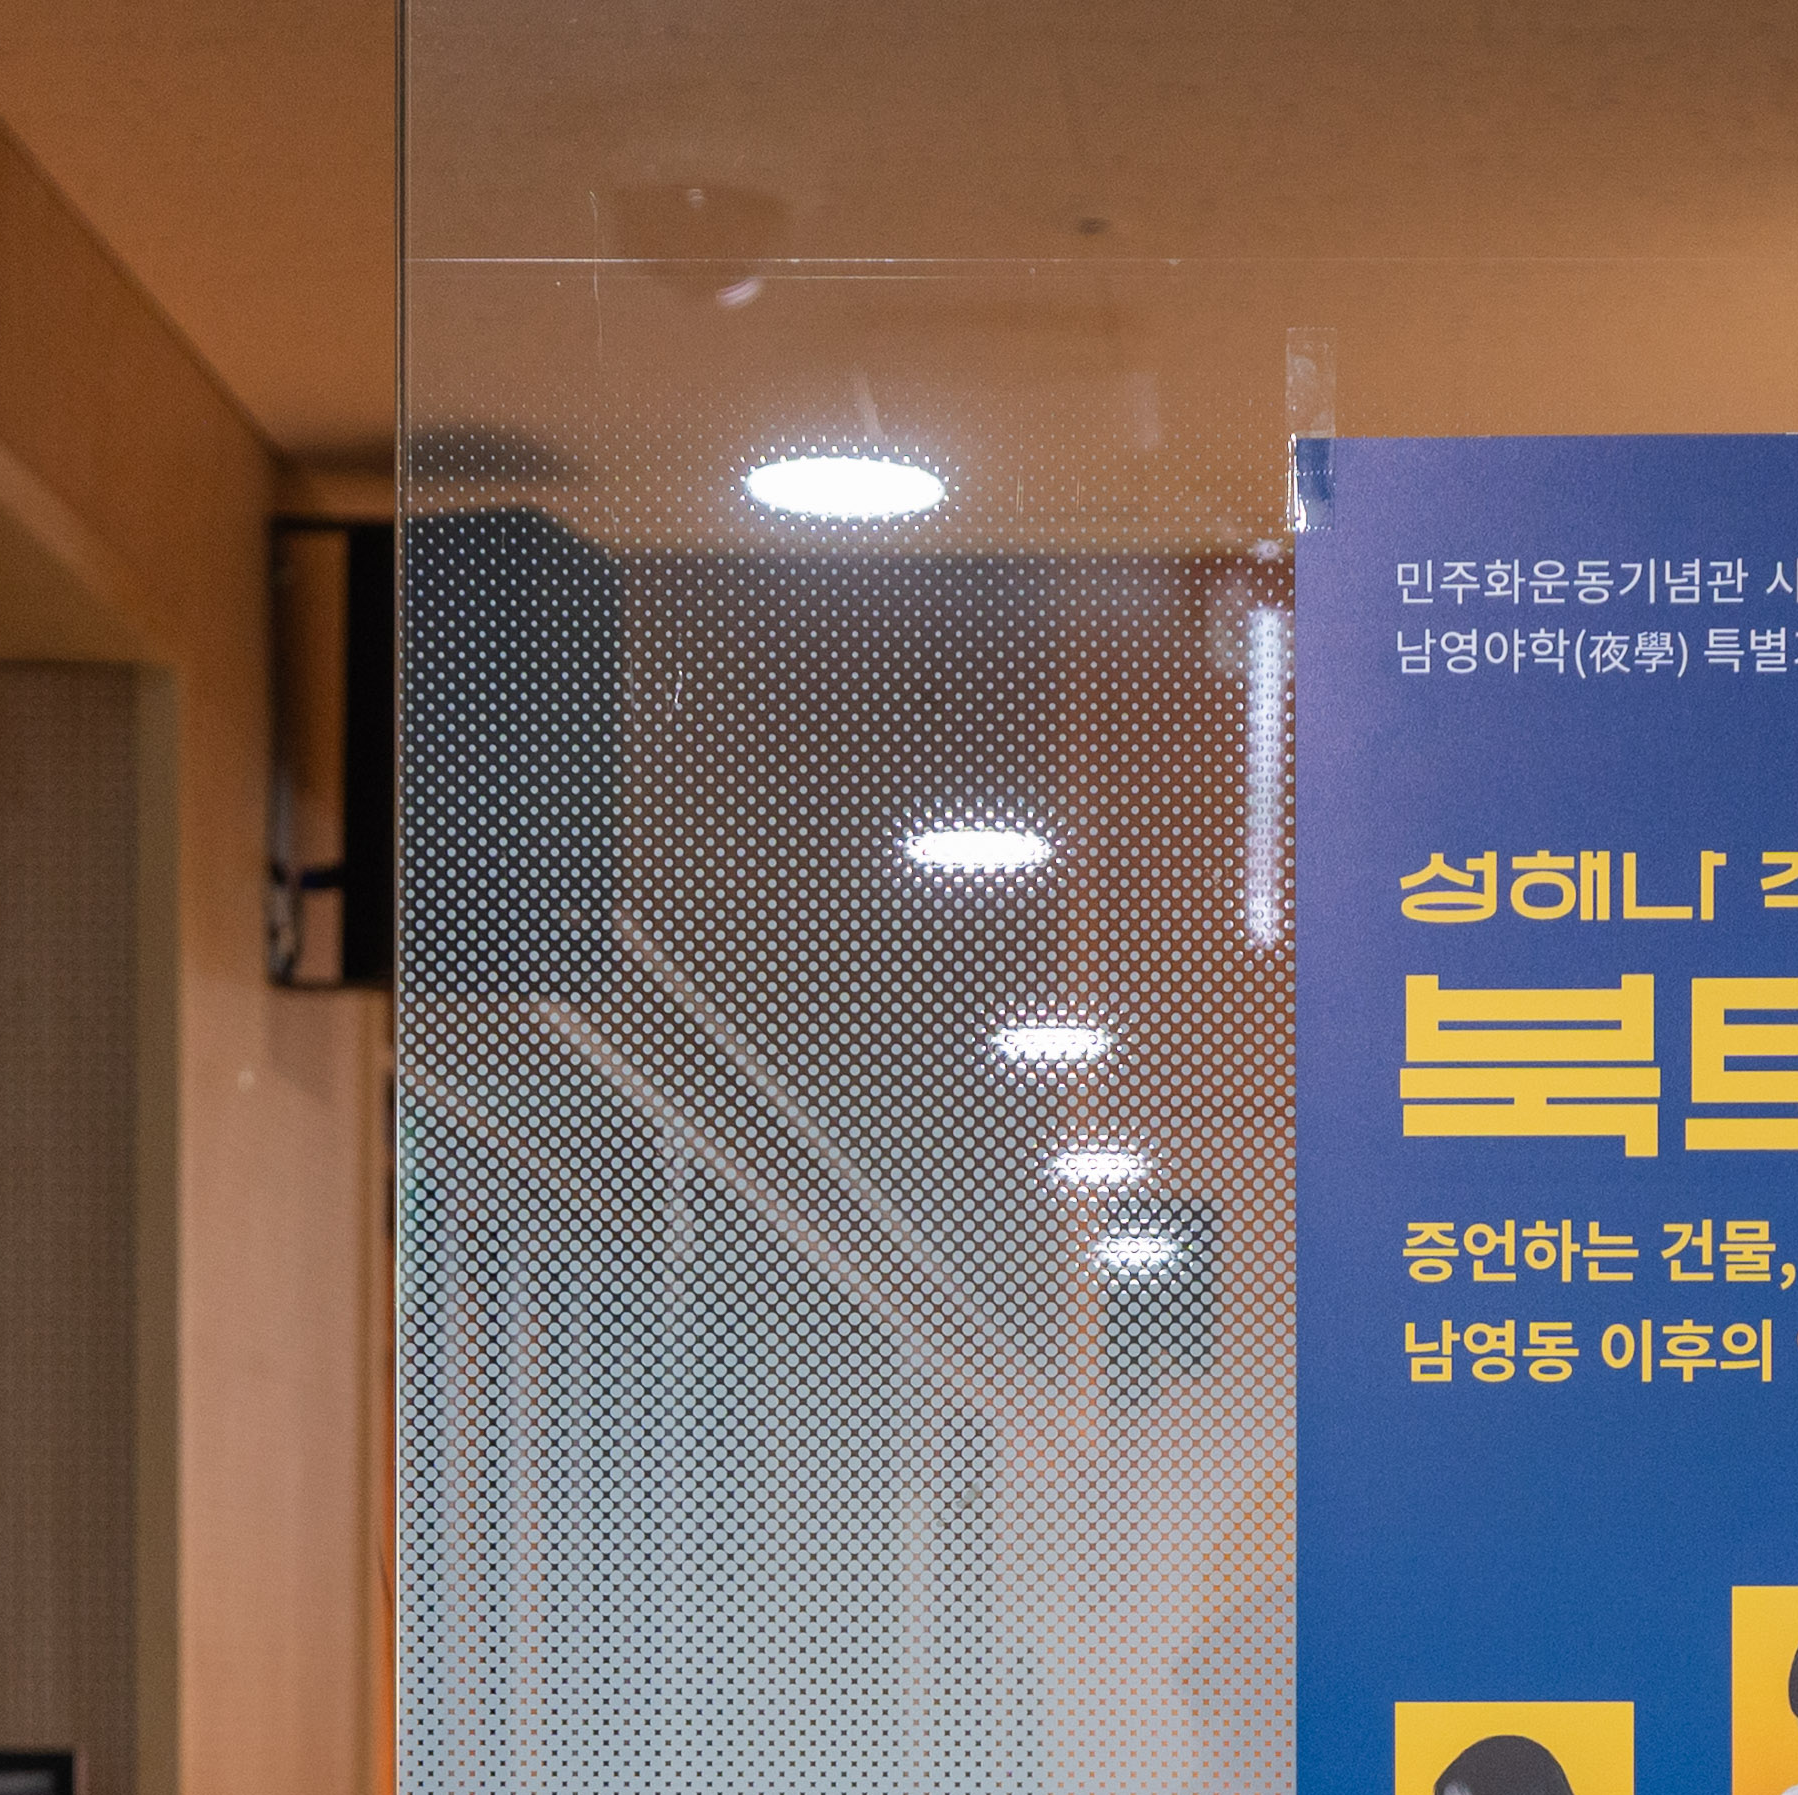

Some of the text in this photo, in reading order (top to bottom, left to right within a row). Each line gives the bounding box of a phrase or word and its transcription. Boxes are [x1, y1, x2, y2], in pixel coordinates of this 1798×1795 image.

[1396, 557, 1749, 606] 민주화운동기념관
[1396, 627, 1688, 680] 남영야학(夜學)
[1399, 849, 1727, 924] 성해나
[1402, 1218, 1640, 1284] 증언하는
[1660, 1218, 1797, 1290] 건물,
[1404, 1319, 1580, 1383] 남영동
[1600, 1318, 1773, 1383] 이후의
